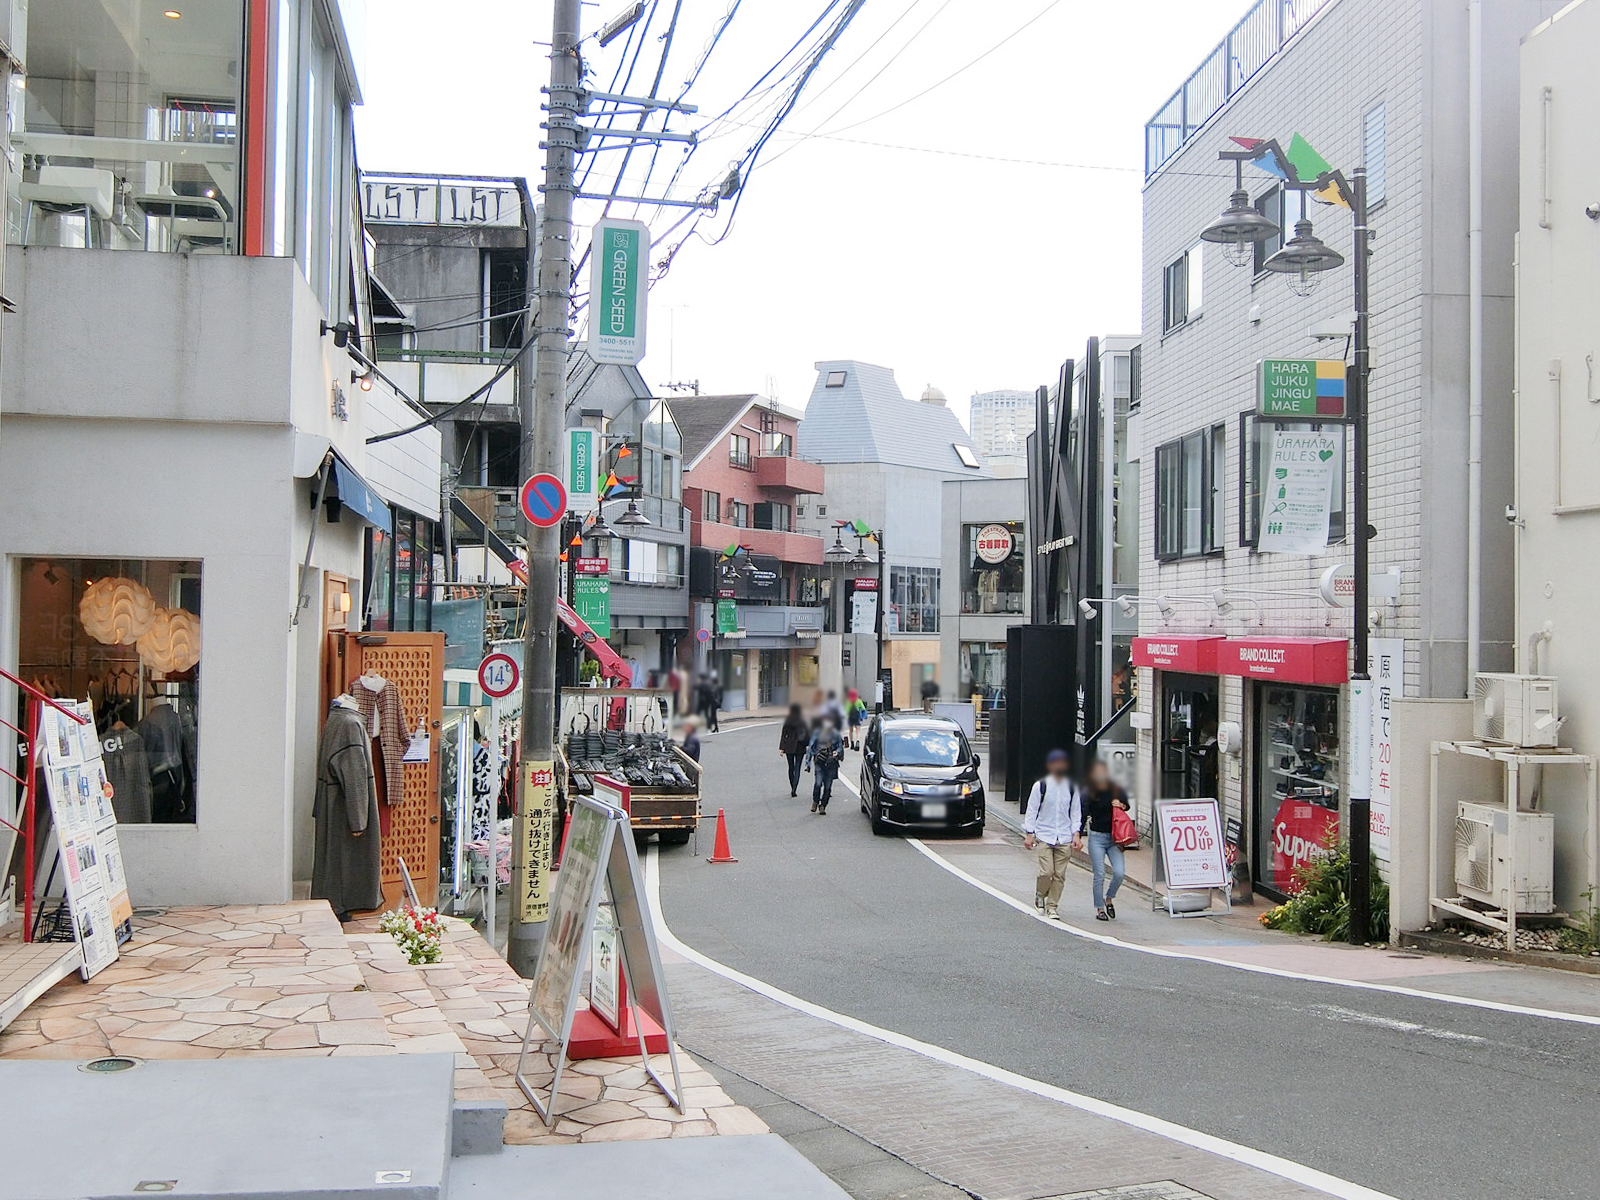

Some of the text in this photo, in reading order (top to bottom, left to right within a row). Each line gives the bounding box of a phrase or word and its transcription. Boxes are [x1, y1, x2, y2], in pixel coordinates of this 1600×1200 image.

[611, 249, 627, 333] GREEN SEED
[1271, 363, 1309, 374] HARA
[1271, 376, 1308, 386] JUKU
[1271, 388, 1311, 399] JINGU
[1271, 400, 1301, 411] MAE
[1276, 438, 1335, 449] URAHARA
[1275, 451, 1316, 462] RULES
[576, 471, 585, 492] SEED
[1147, 643, 1160, 655] BRAND
[1240, 647, 1259, 661] BRAND
[534, 773, 552, 784] 注意
[1368, 810, 1386, 824] RAND
[1368, 822, 1391, 837] OLLECT
[1198, 837, 1213, 850] UP
[526, 808, 542, 900] 通り抜けできません
